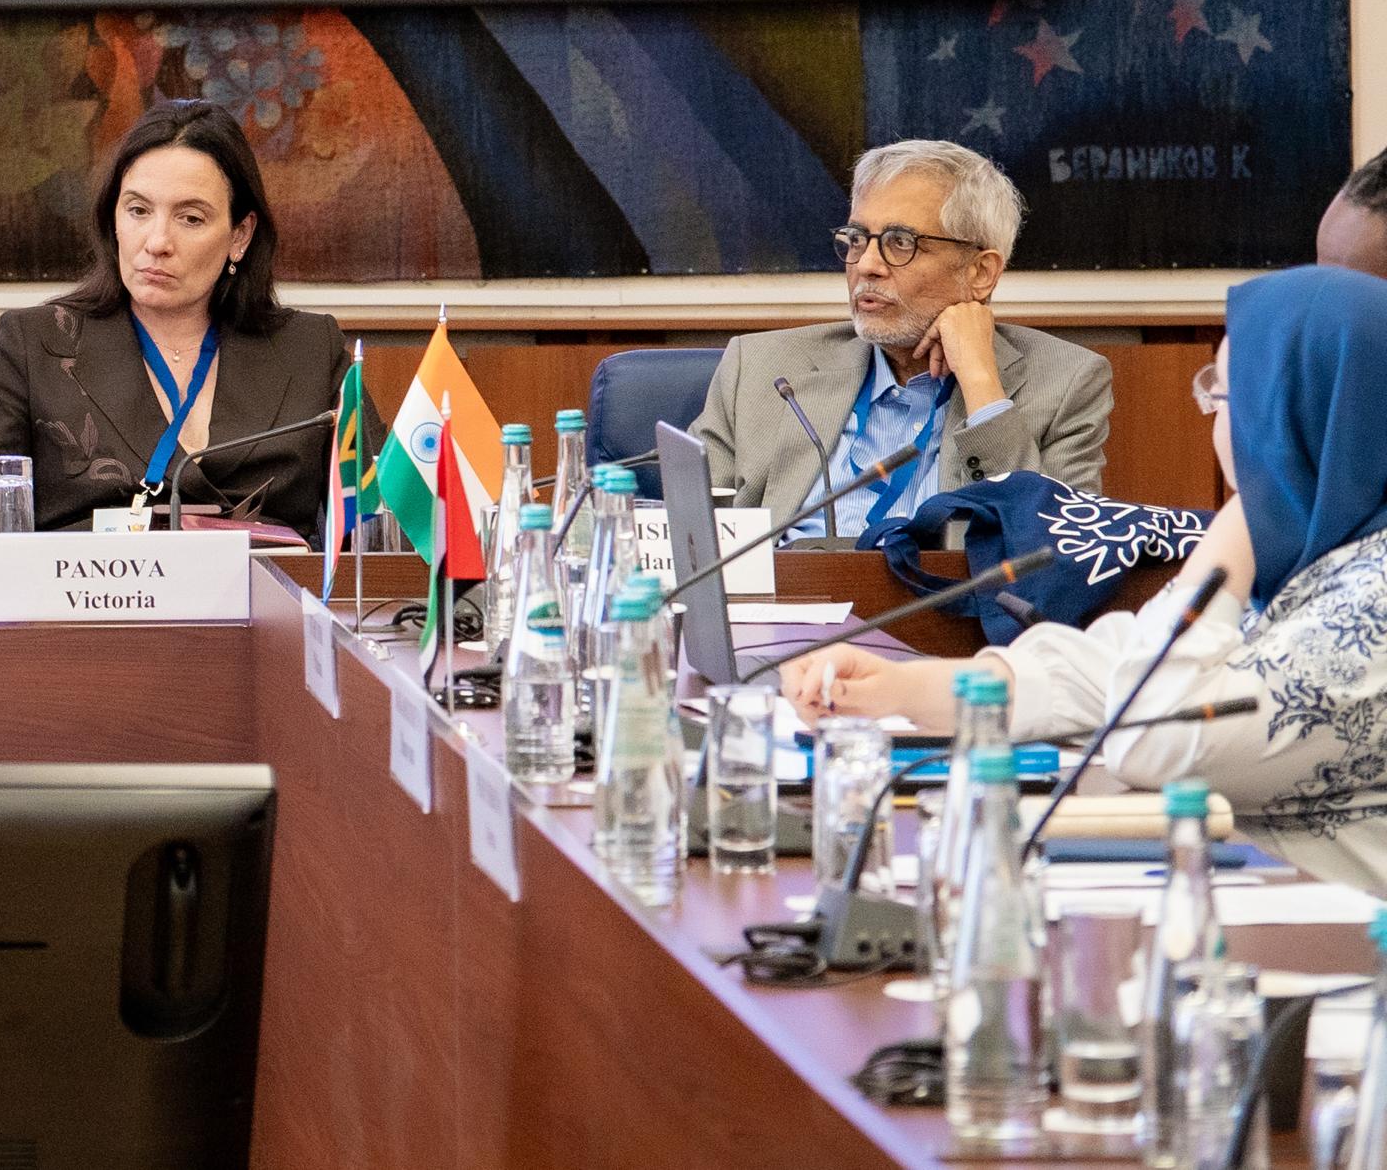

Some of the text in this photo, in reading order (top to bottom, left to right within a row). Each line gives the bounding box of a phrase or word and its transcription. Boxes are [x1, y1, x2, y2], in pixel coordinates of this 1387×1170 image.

[1231, 143, 1252, 180] К
[55, 559, 165, 579] PANOVA
[65, 589, 157, 610] Victoria
